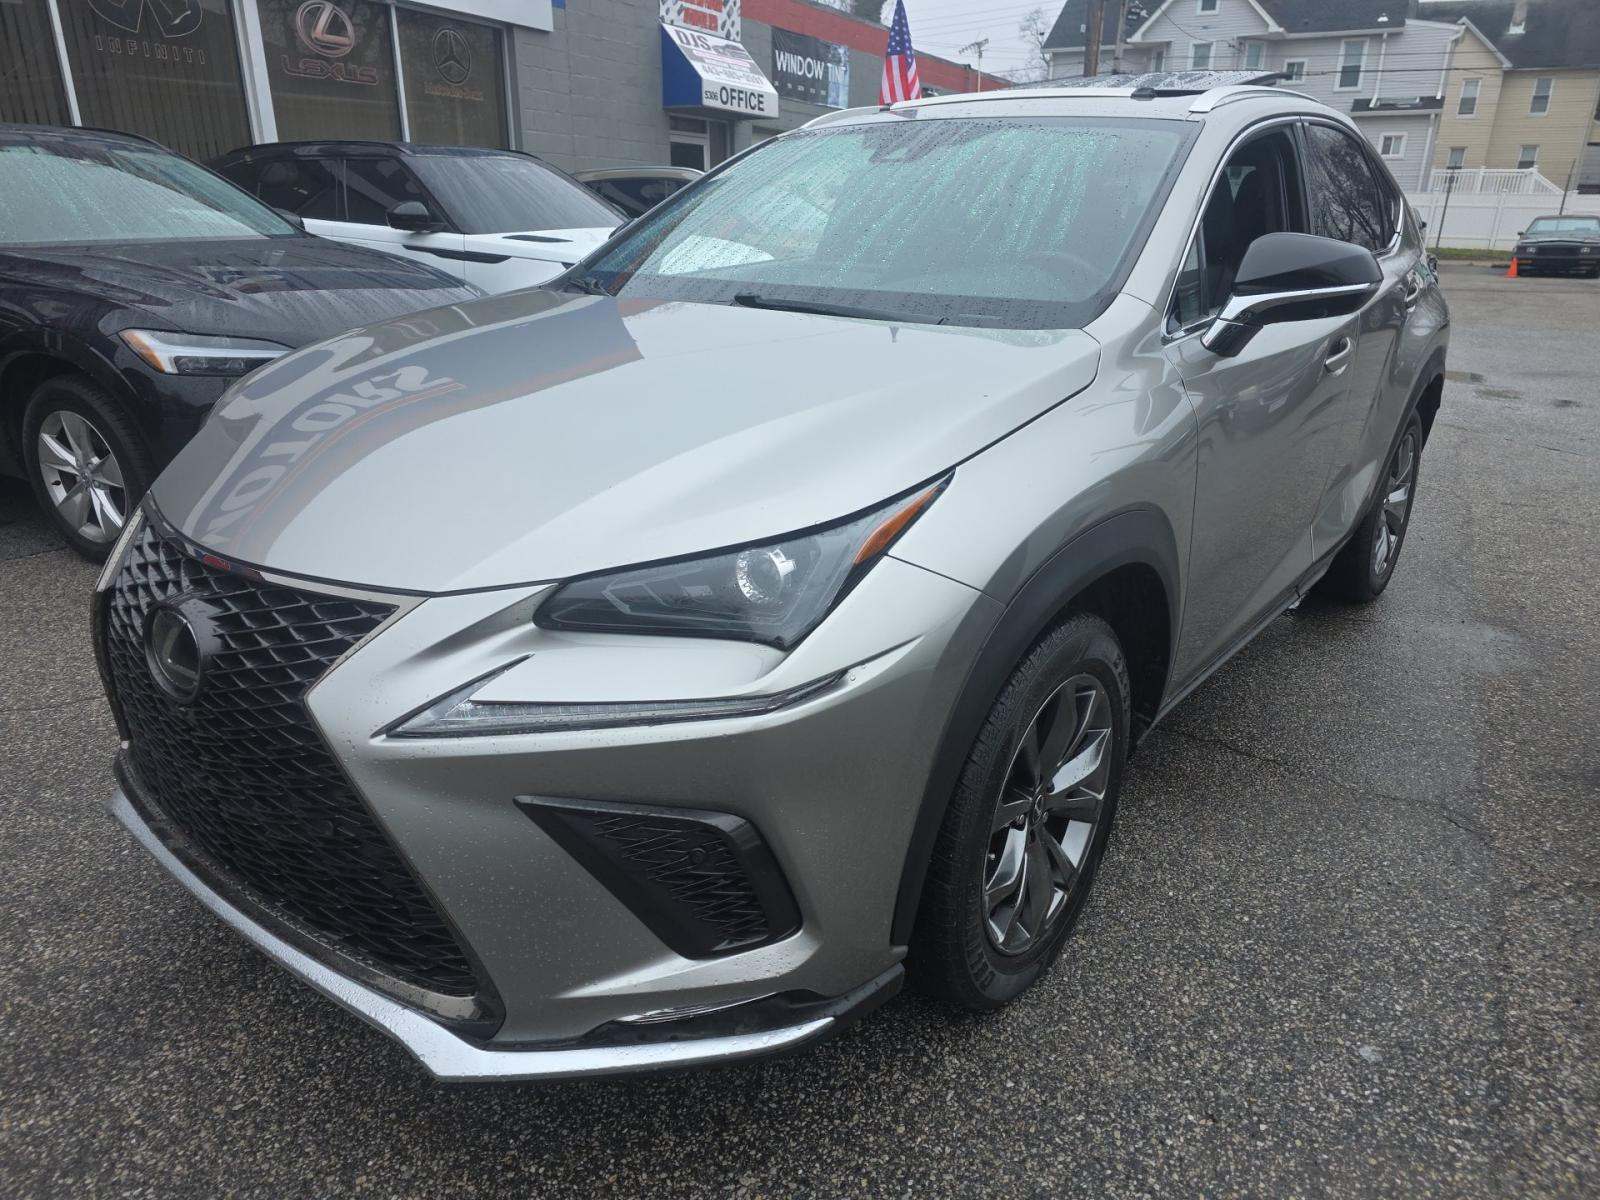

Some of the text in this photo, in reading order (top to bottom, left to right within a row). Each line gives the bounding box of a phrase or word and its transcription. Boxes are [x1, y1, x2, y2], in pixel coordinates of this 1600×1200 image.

[94, 34, 207, 65] INFINITI
[674, 29, 711, 50] DJS
[279, 54, 380, 86] LEXUS
[775, 49, 825, 81] WINDOW
[826, 62, 847, 82] TINT
[719, 86, 765, 112] OFFICE
